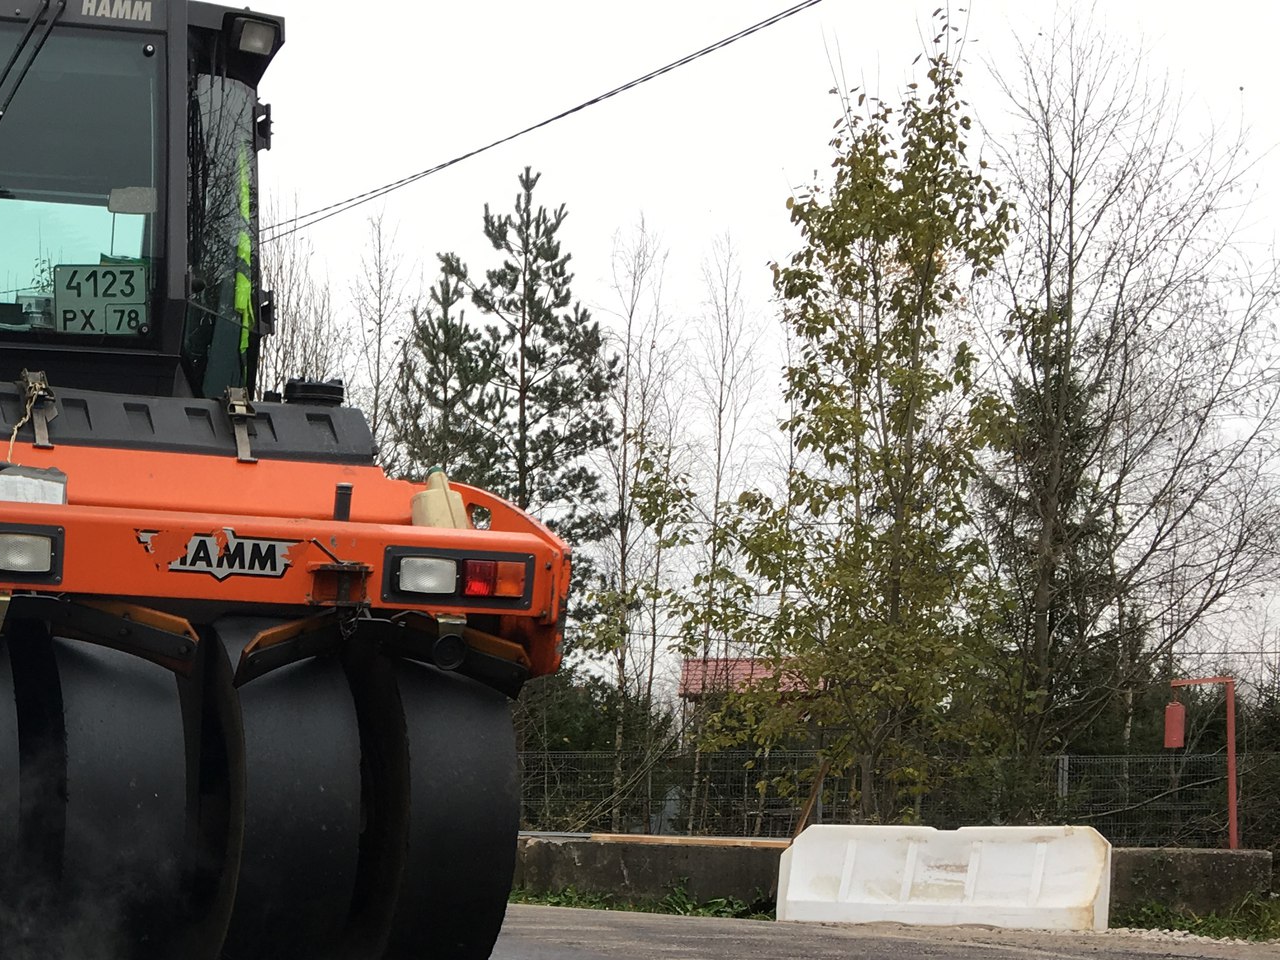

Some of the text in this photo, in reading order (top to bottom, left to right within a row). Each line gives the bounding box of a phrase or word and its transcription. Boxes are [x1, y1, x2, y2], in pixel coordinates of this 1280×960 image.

[81, 0, 152, 22] HAMM
[65, 269, 136, 298] 4123
[113, 309, 140, 331] 78
[178, 539, 278, 572] AMM
